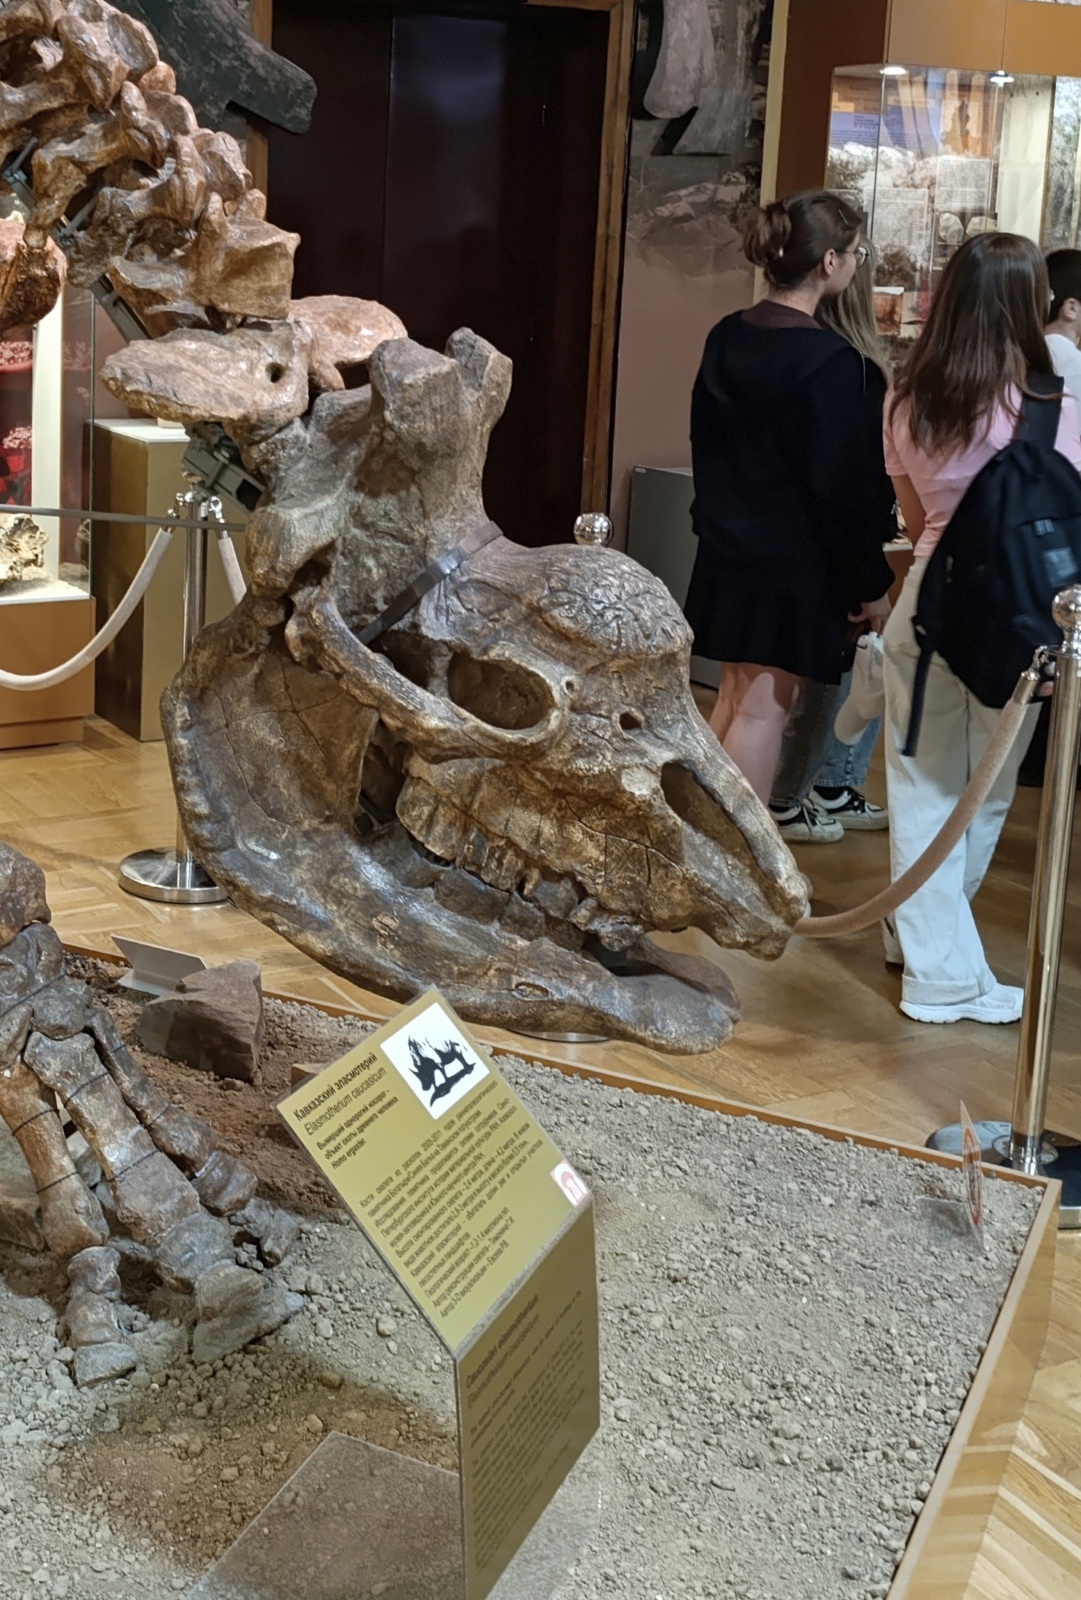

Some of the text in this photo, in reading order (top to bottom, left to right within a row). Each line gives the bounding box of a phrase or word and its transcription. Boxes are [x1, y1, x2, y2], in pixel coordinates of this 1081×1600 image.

[293, 1051, 378, 1121] Кавказский эласмотерий
[303, 1066, 387, 1135] Elasmotherium caucasicum
[316, 1124, 345, 1150] Вымерший
[343, 1104, 369, 1128] однорогий
[367, 1090, 386, 1108] носорог
[324, 1096, 398, 1159] объект охоты древнего человека
[330, 1154, 347, 1169] Homo
